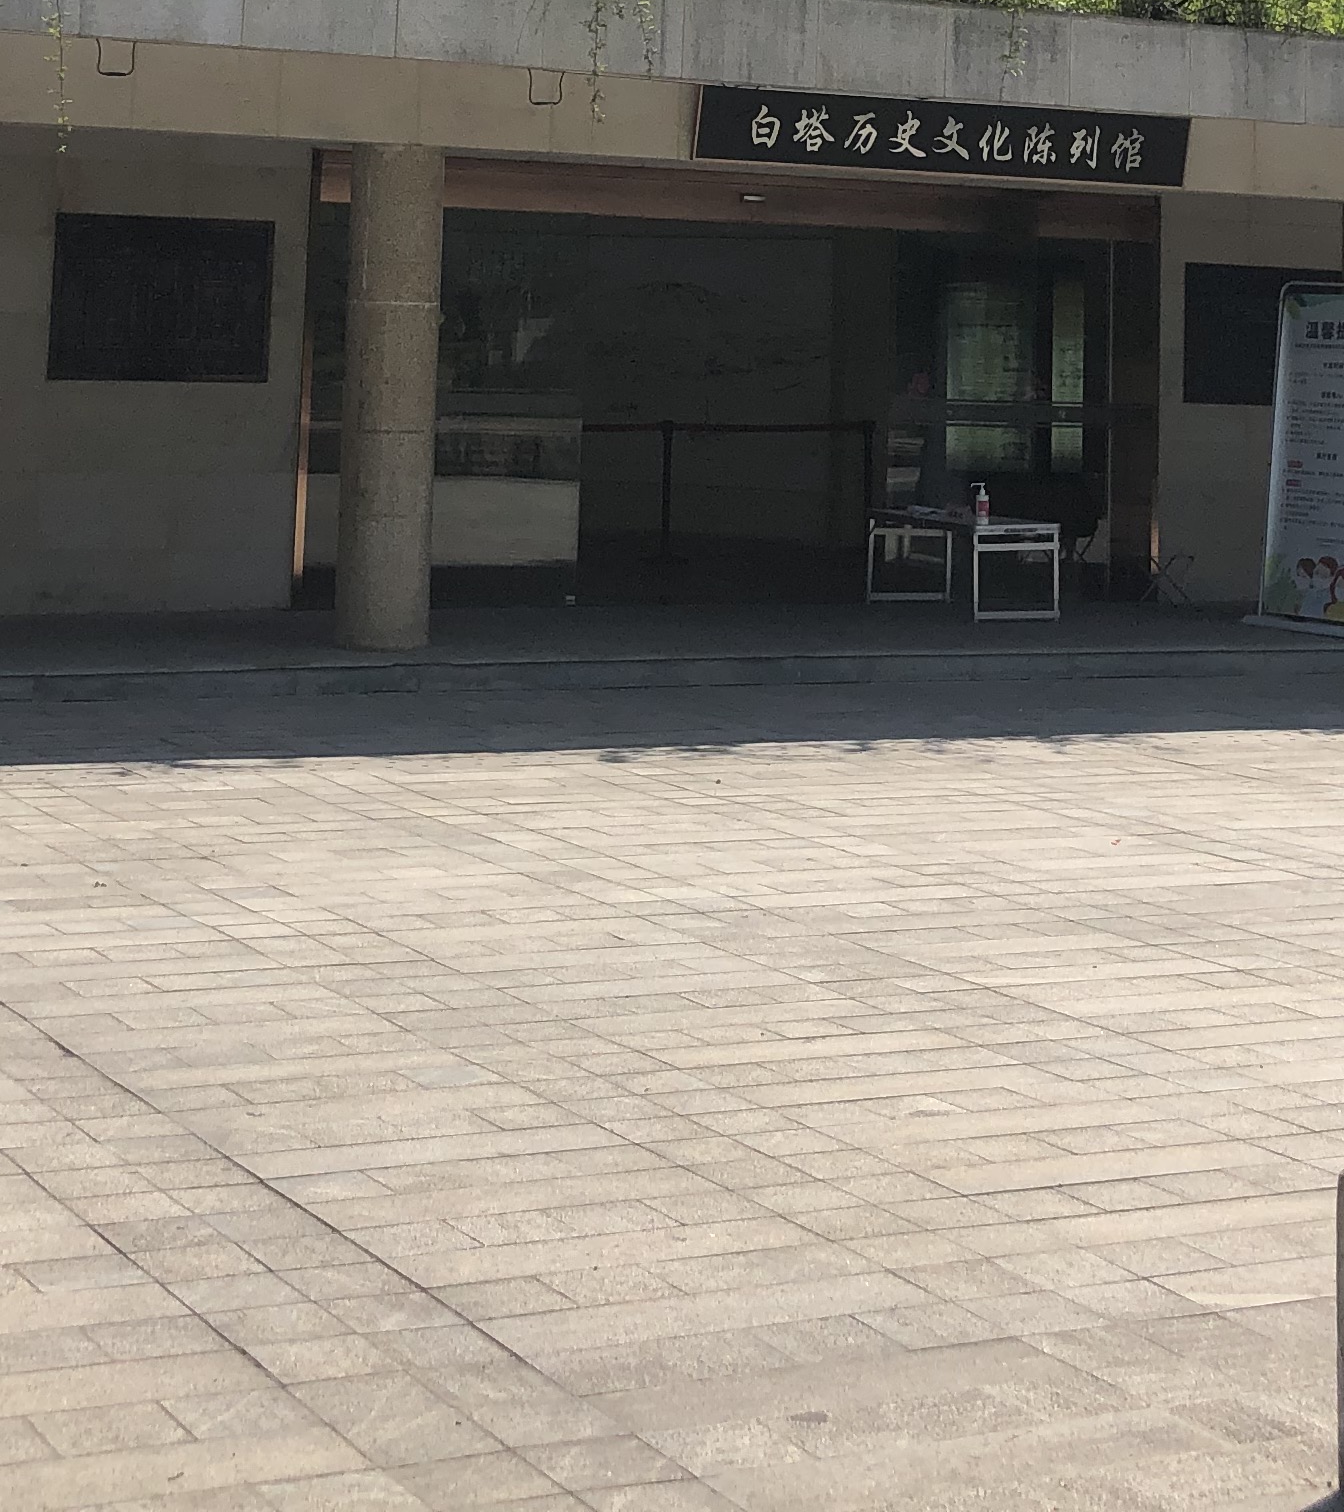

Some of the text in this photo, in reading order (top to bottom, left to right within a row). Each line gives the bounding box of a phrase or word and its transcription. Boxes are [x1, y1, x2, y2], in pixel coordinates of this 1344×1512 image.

[750, 104, 1146, 173] 白塔历史文化陈列馆
